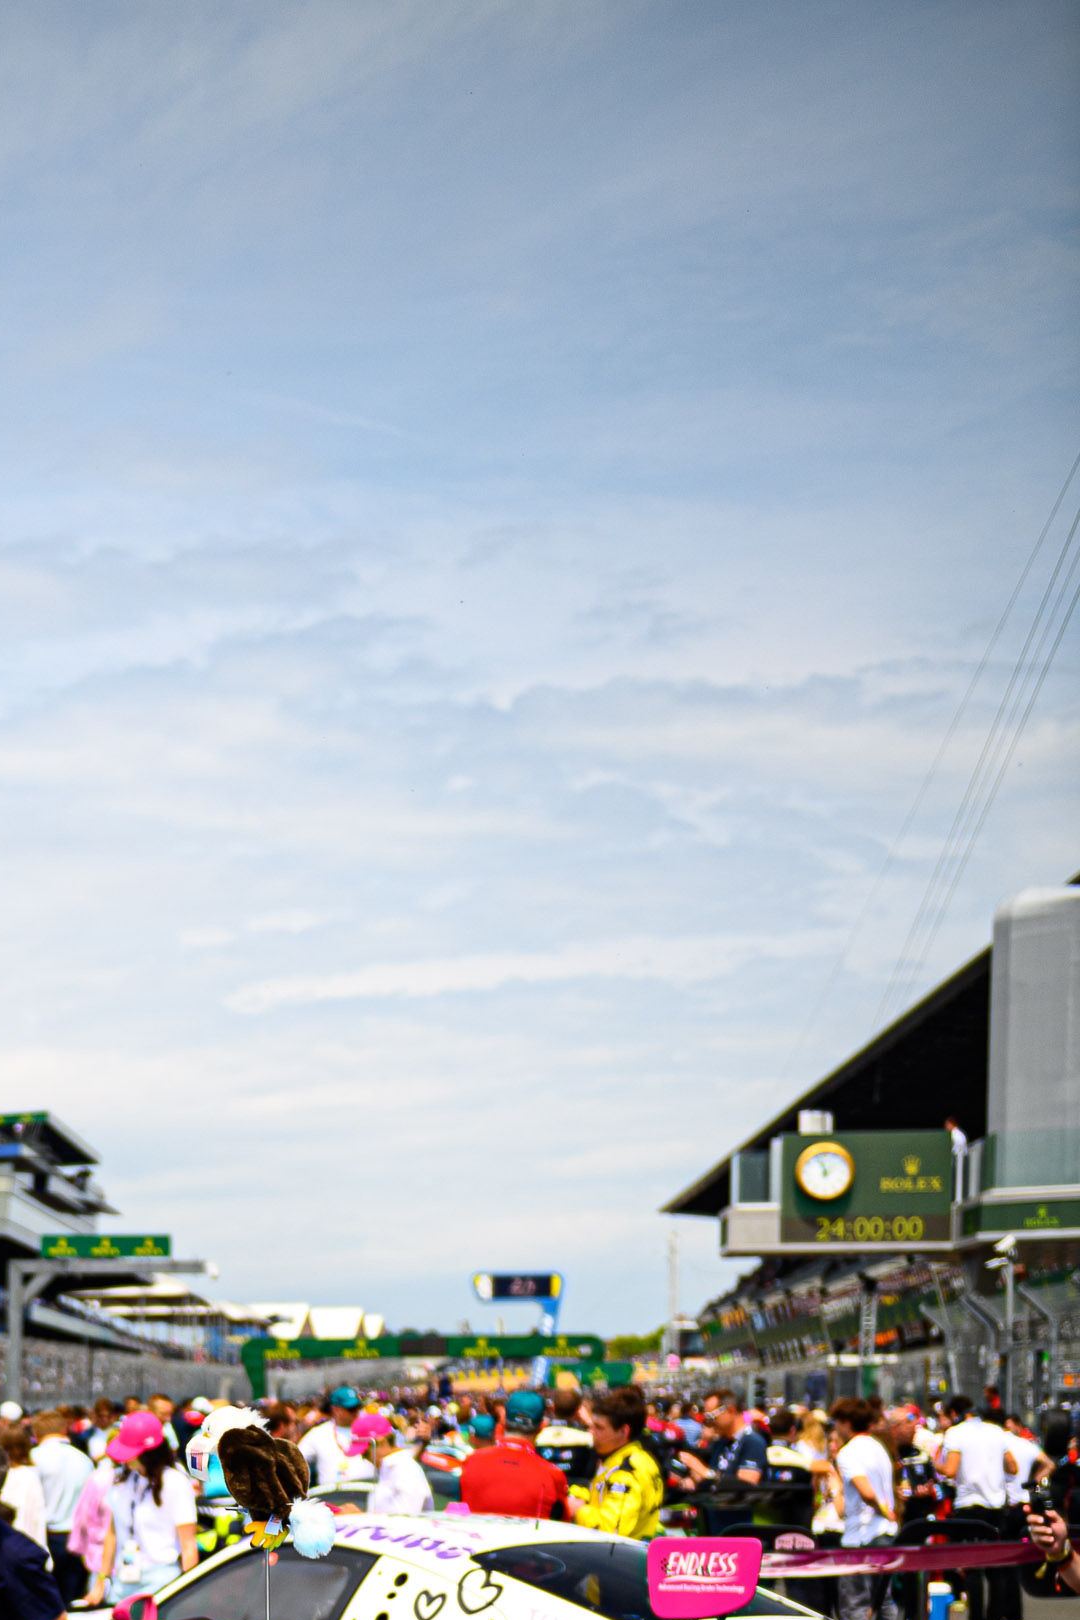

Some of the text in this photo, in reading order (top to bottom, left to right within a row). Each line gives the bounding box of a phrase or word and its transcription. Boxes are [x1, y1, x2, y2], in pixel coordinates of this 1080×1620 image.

[880, 1176, 942, 1193] ROLEX
[815, 1215, 924, 1242] 24:00:00
[666, 1551, 738, 1577] ENDLESS
